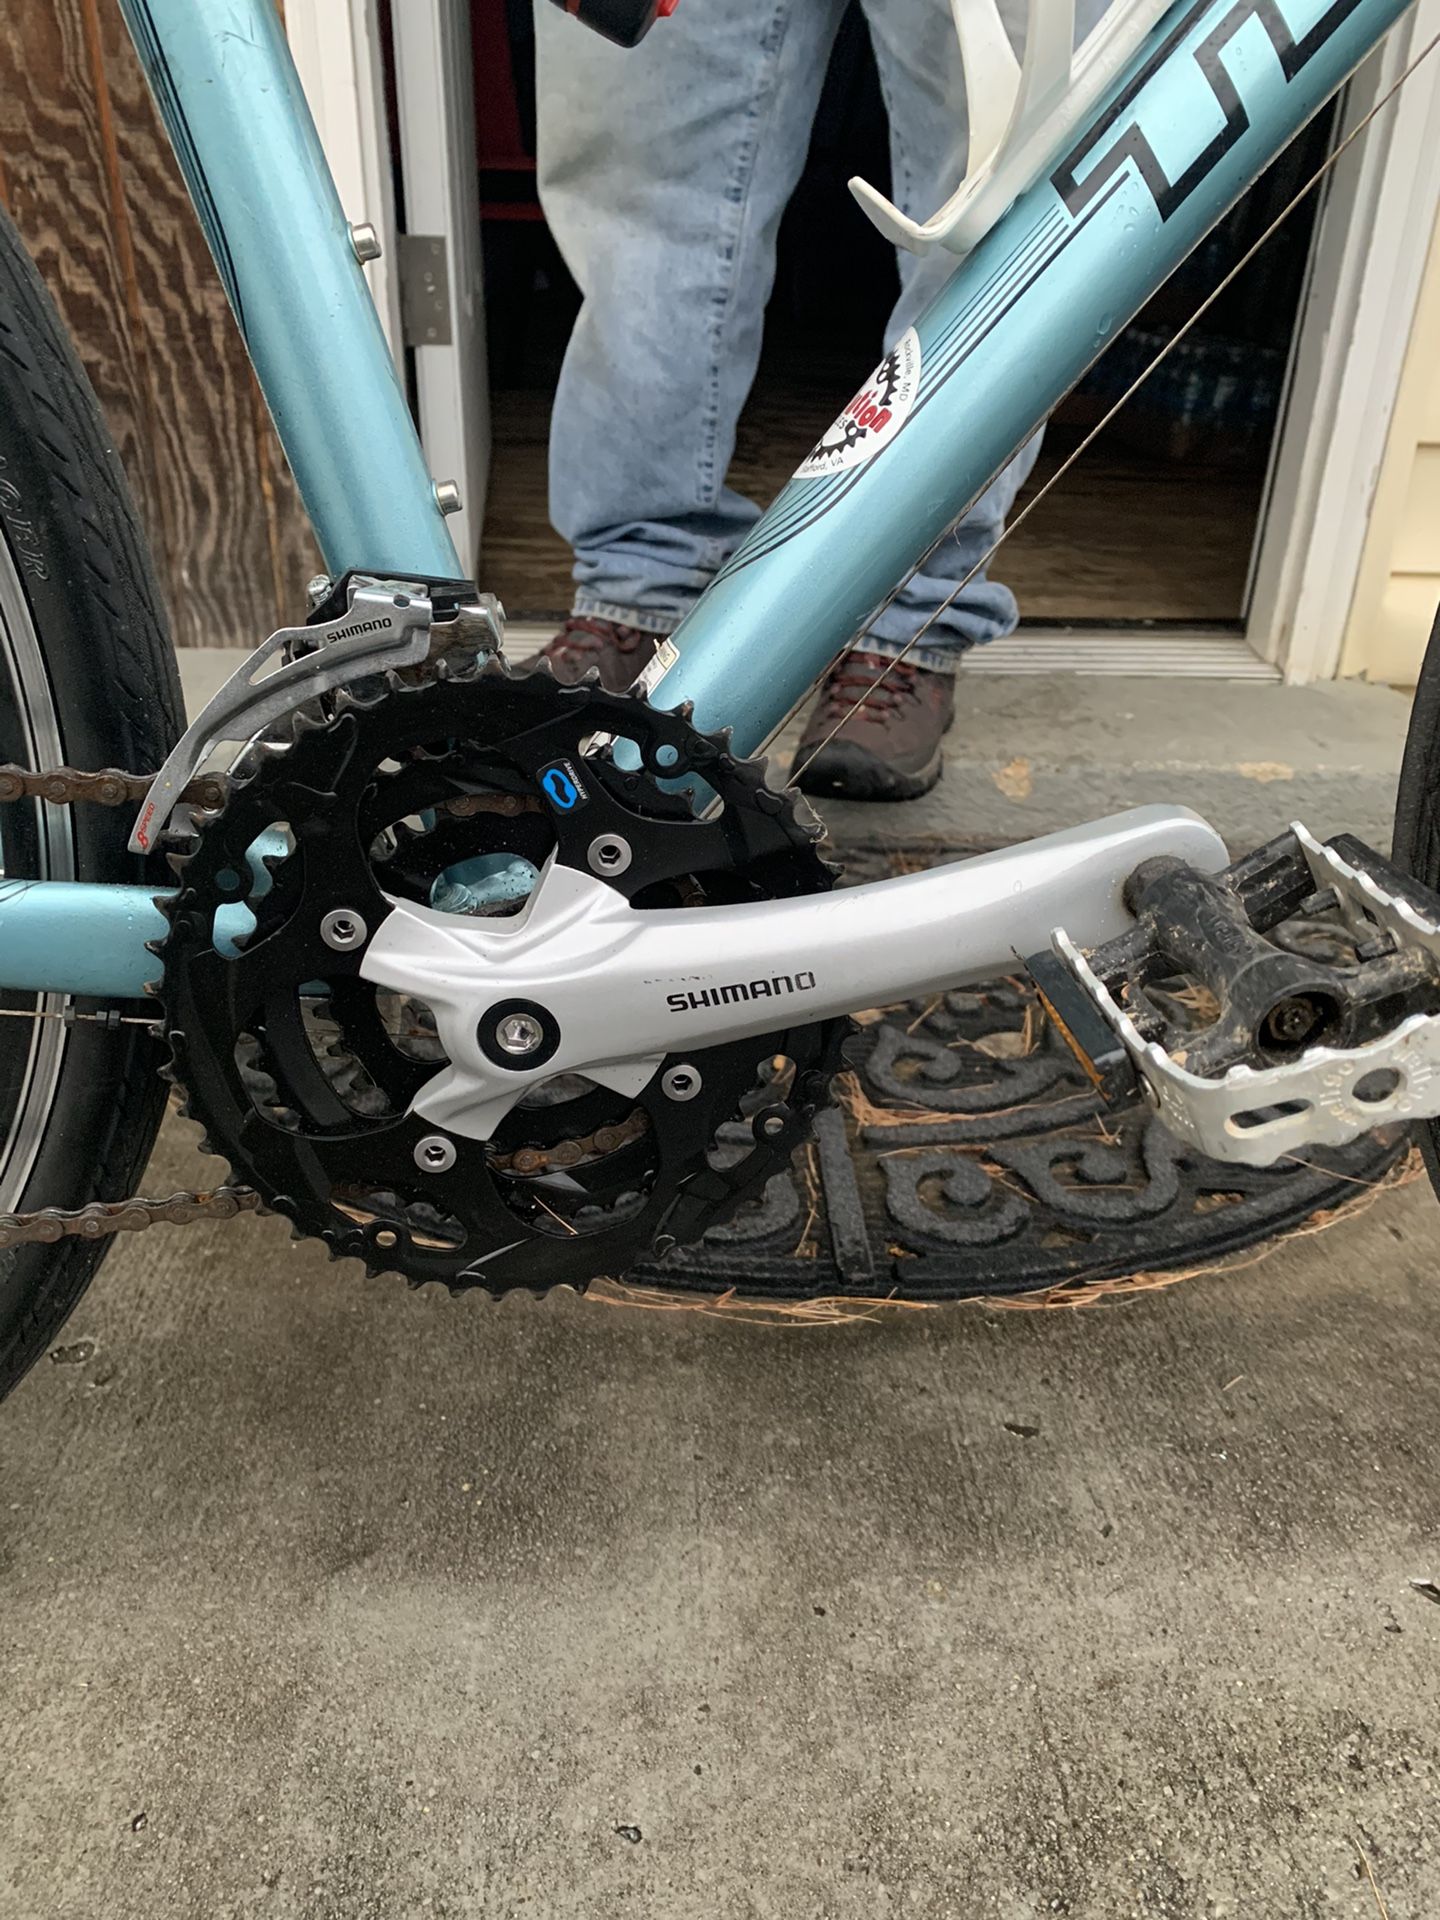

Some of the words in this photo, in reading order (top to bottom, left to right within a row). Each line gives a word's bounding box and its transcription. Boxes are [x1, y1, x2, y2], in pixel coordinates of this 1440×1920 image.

[899, 382, 911, 402] MD
[845, 389, 892, 433] tion
[831, 457, 844, 467] VA
[327, 617, 392, 644] SHIMANO
[666, 971, 816, 1012] SHIMANO
